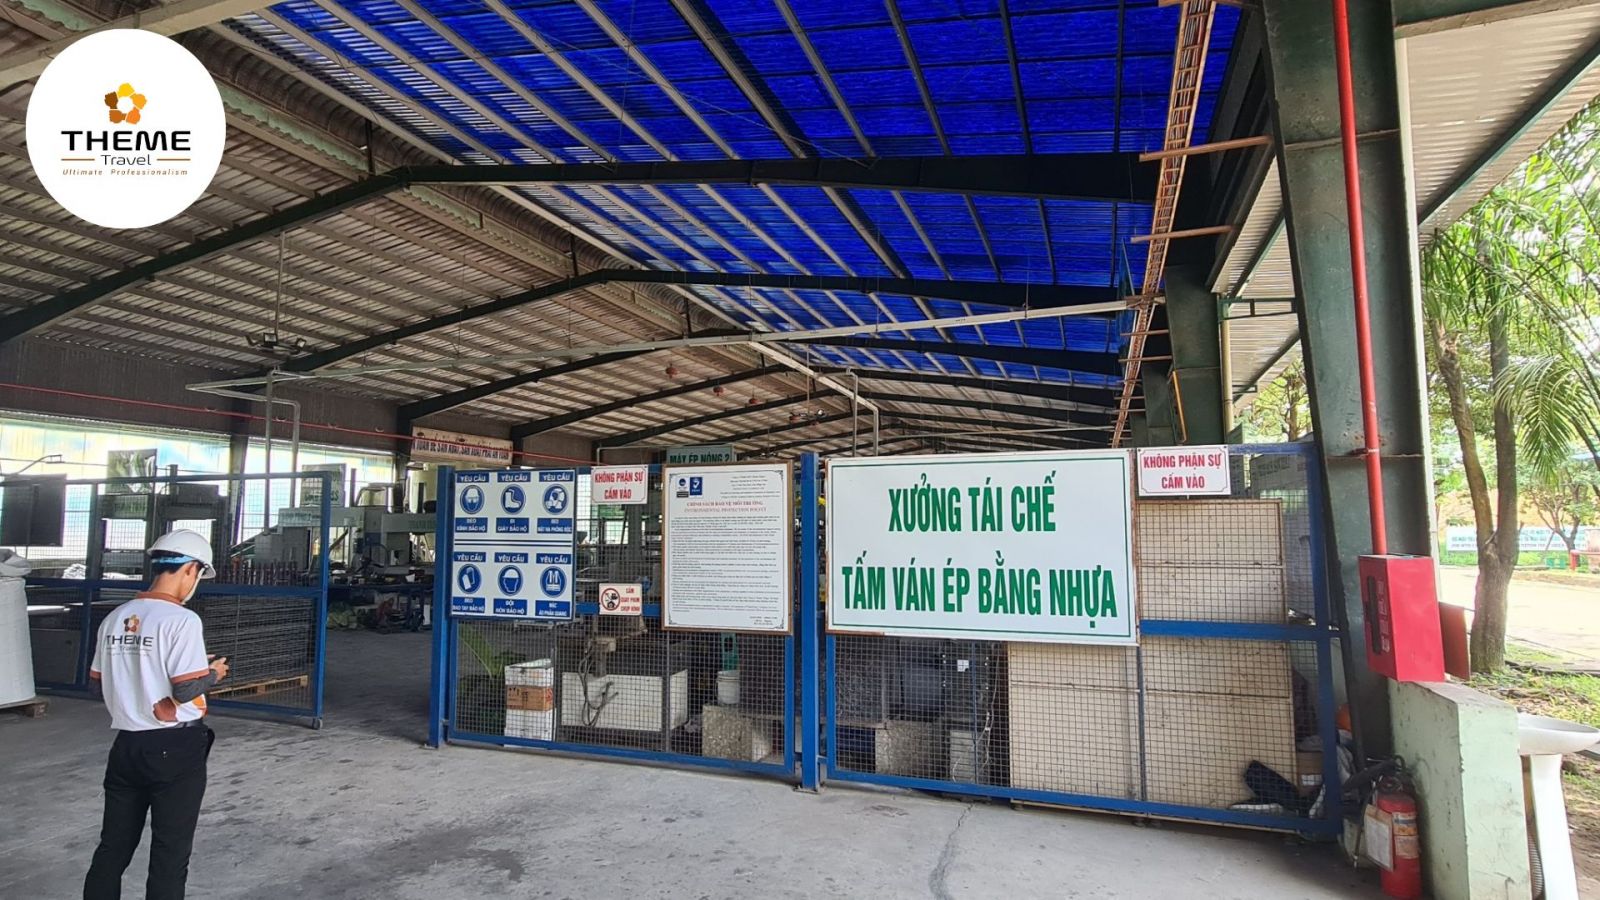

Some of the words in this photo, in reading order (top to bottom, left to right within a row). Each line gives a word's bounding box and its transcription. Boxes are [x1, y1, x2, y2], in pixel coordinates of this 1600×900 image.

[1143, 453, 1176, 468] KHÔNG
[1178, 452, 1205, 470] PHẬN
[1208, 452, 1222, 469] SỰ
[1161, 472, 1183, 489] CẤM
[1186, 473, 1205, 488] VÀO
[888, 473, 962, 532] XƯỞNG
[968, 477, 1004, 532] TÁI
[1011, 470, 1056, 532] CHẾ
[841, 550, 886, 610] TẤM
[892, 557, 936, 611] VÁN
[943, 557, 970, 613] ÉP
[978, 550, 1042, 615] BẰNG
[1050, 565, 1118, 628] NHỰA
[106, 635, 154, 647] THEME
